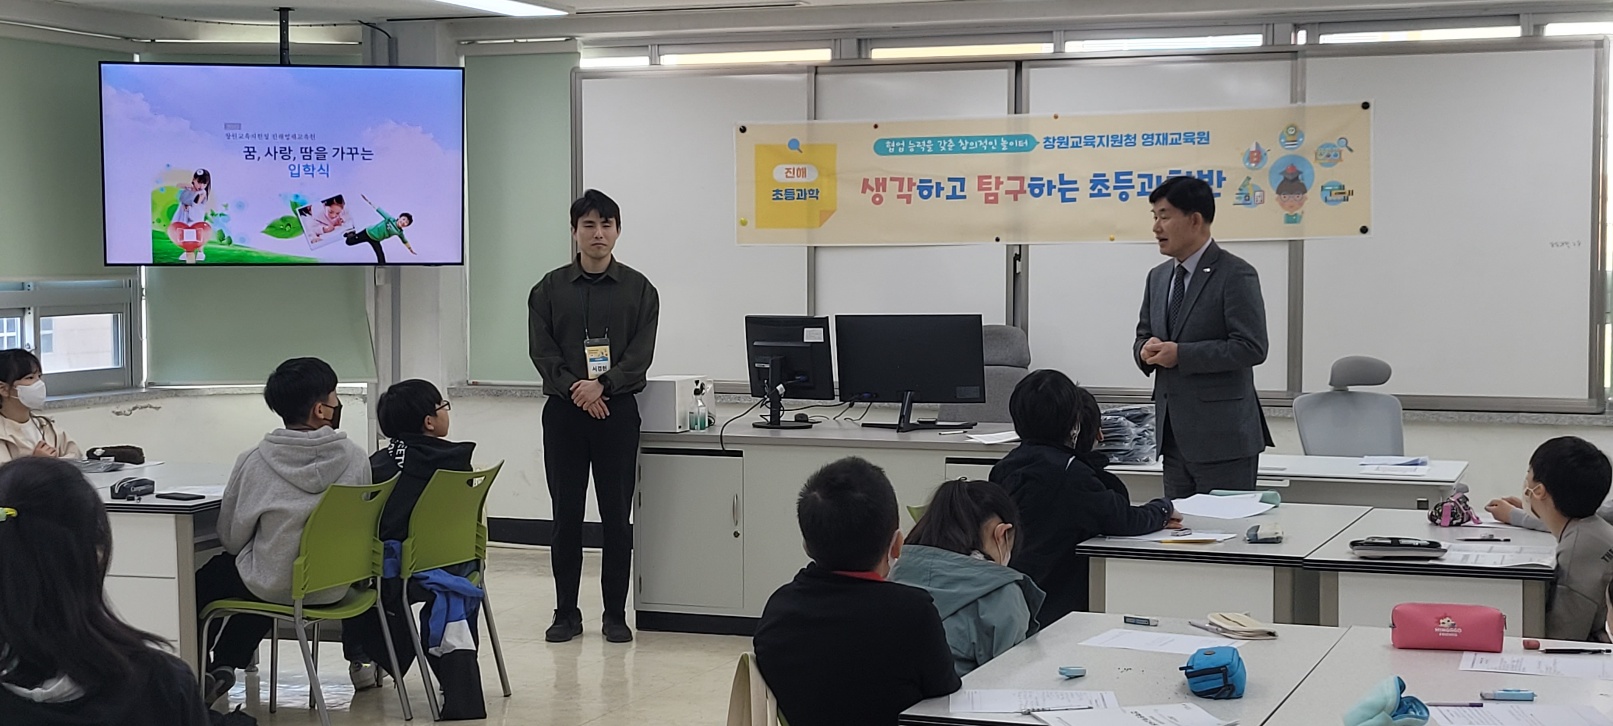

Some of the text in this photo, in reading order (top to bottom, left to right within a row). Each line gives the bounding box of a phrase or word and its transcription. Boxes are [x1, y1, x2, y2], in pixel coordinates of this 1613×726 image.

[885, 137, 1028, 153] 협업 능력을 갖춘 창의적인 놀이터
[1043, 130, 1211, 150] 창원교육지원청 영재교육원
[243, 145, 374, 161] 꿈, 사랑, 땀을 가꾸는
[288, 163, 330, 178] 입학식
[772, 188, 820, 201] 초등과학
[860, 176, 967, 206] 생각하고
[977, 173, 1079, 204] 탐구하는
